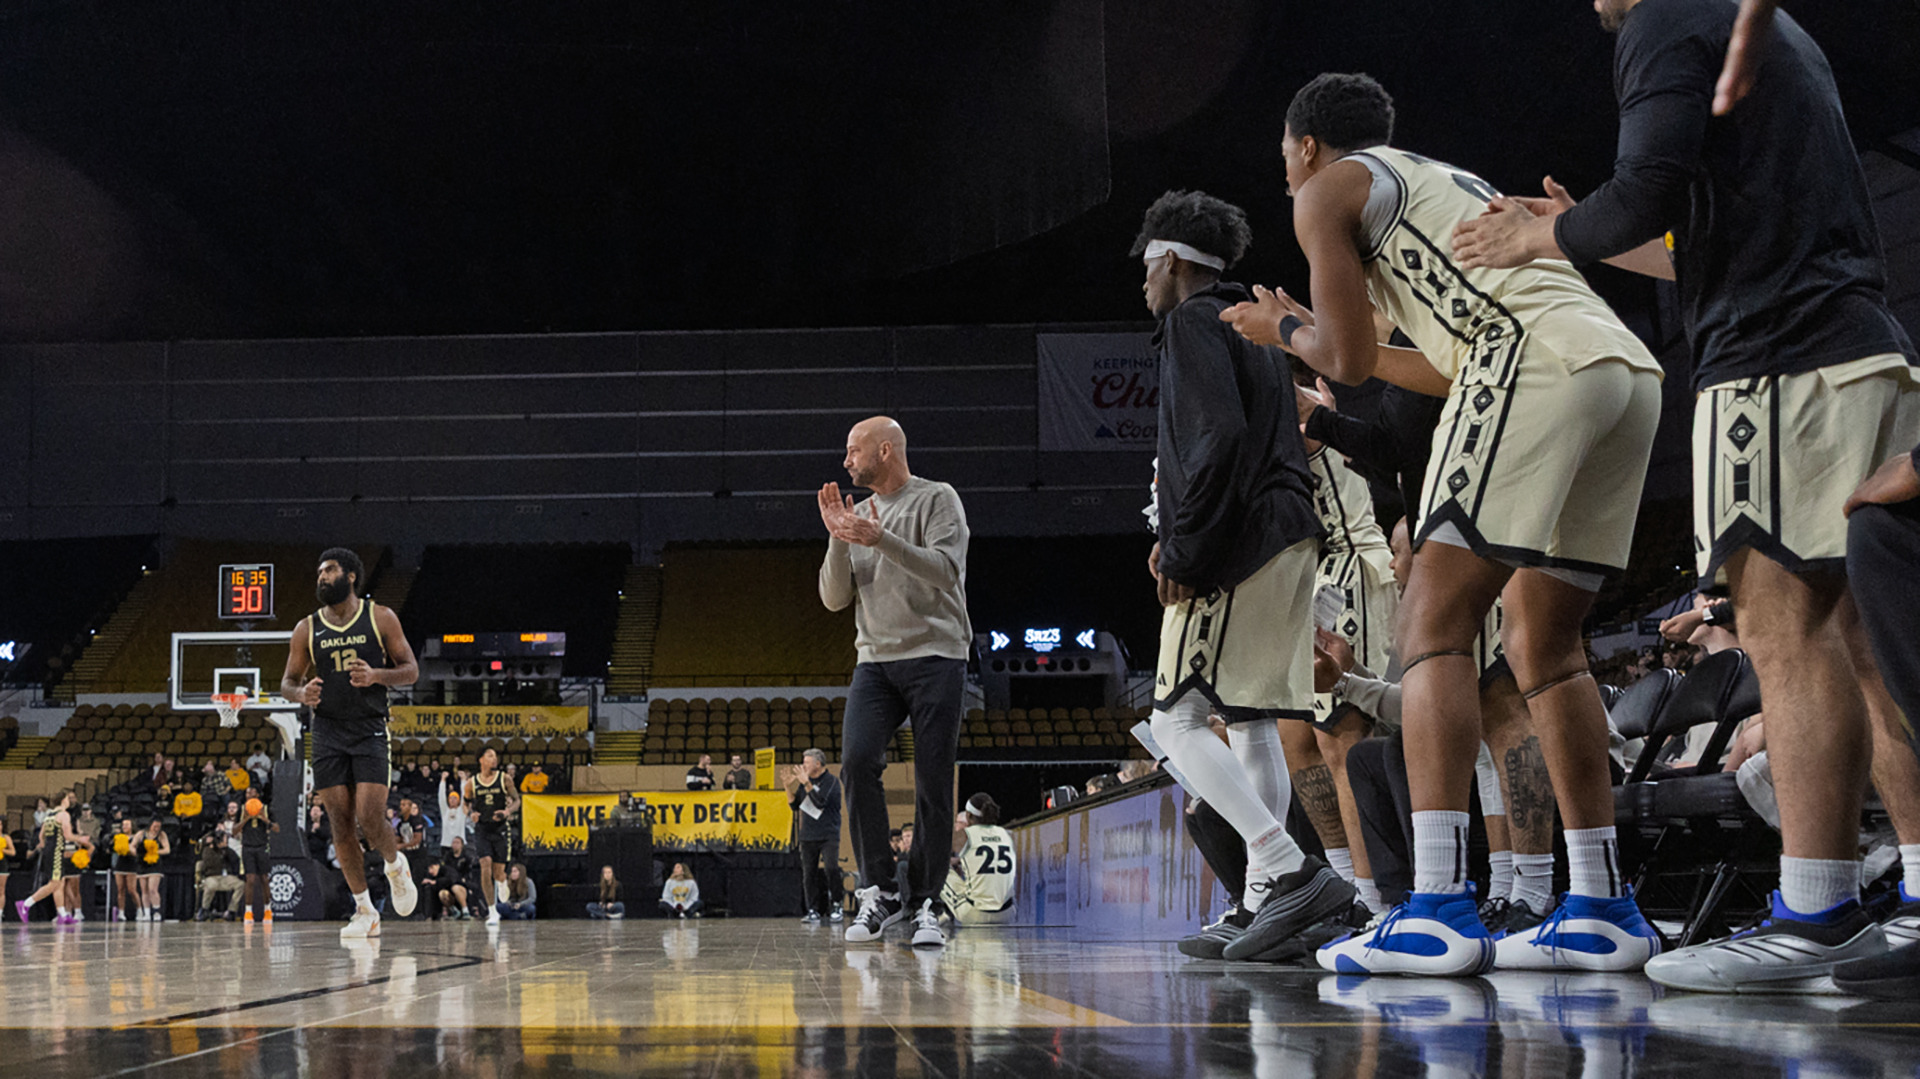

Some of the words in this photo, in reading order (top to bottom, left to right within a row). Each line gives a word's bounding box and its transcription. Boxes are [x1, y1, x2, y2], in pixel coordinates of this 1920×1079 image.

[1093, 357, 1153, 370] KEEPING
[231, 571, 245, 585] 16
[250, 571, 267, 585] 35
[232, 586, 262, 613] 30
[320, 635, 367, 648] OAKLAND
[330, 648, 358, 672] 12
[416, 713, 439, 725] THE
[443, 713, 480, 725] ROAR
[485, 713, 521, 725] ZONE
[485, 794, 494, 805] 2
[554, 805, 606, 827] MKE
[645, 804, 685, 825] RTY
[693, 802, 757, 824] DECK!
[975, 844, 1013, 875] 25
